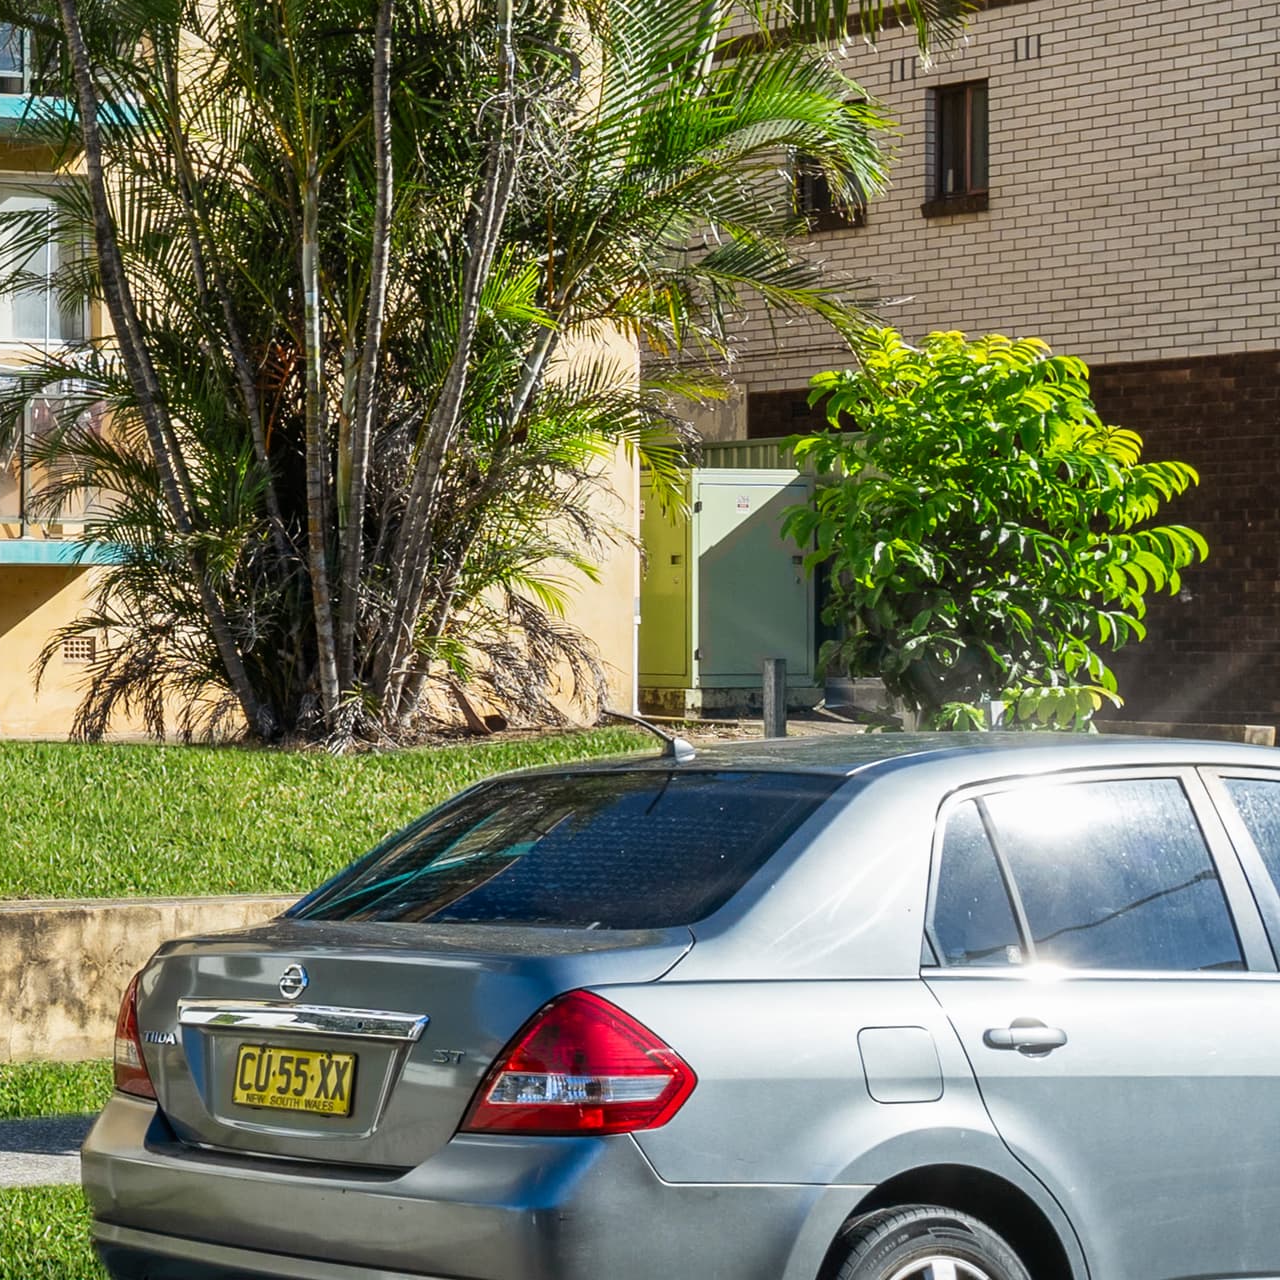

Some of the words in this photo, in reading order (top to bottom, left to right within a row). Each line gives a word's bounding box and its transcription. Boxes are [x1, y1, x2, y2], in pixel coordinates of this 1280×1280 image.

[246, 1093, 265, 1103] NEW
[270, 1095, 300, 1107] SOUTH
[304, 1099, 334, 1111] WALES
